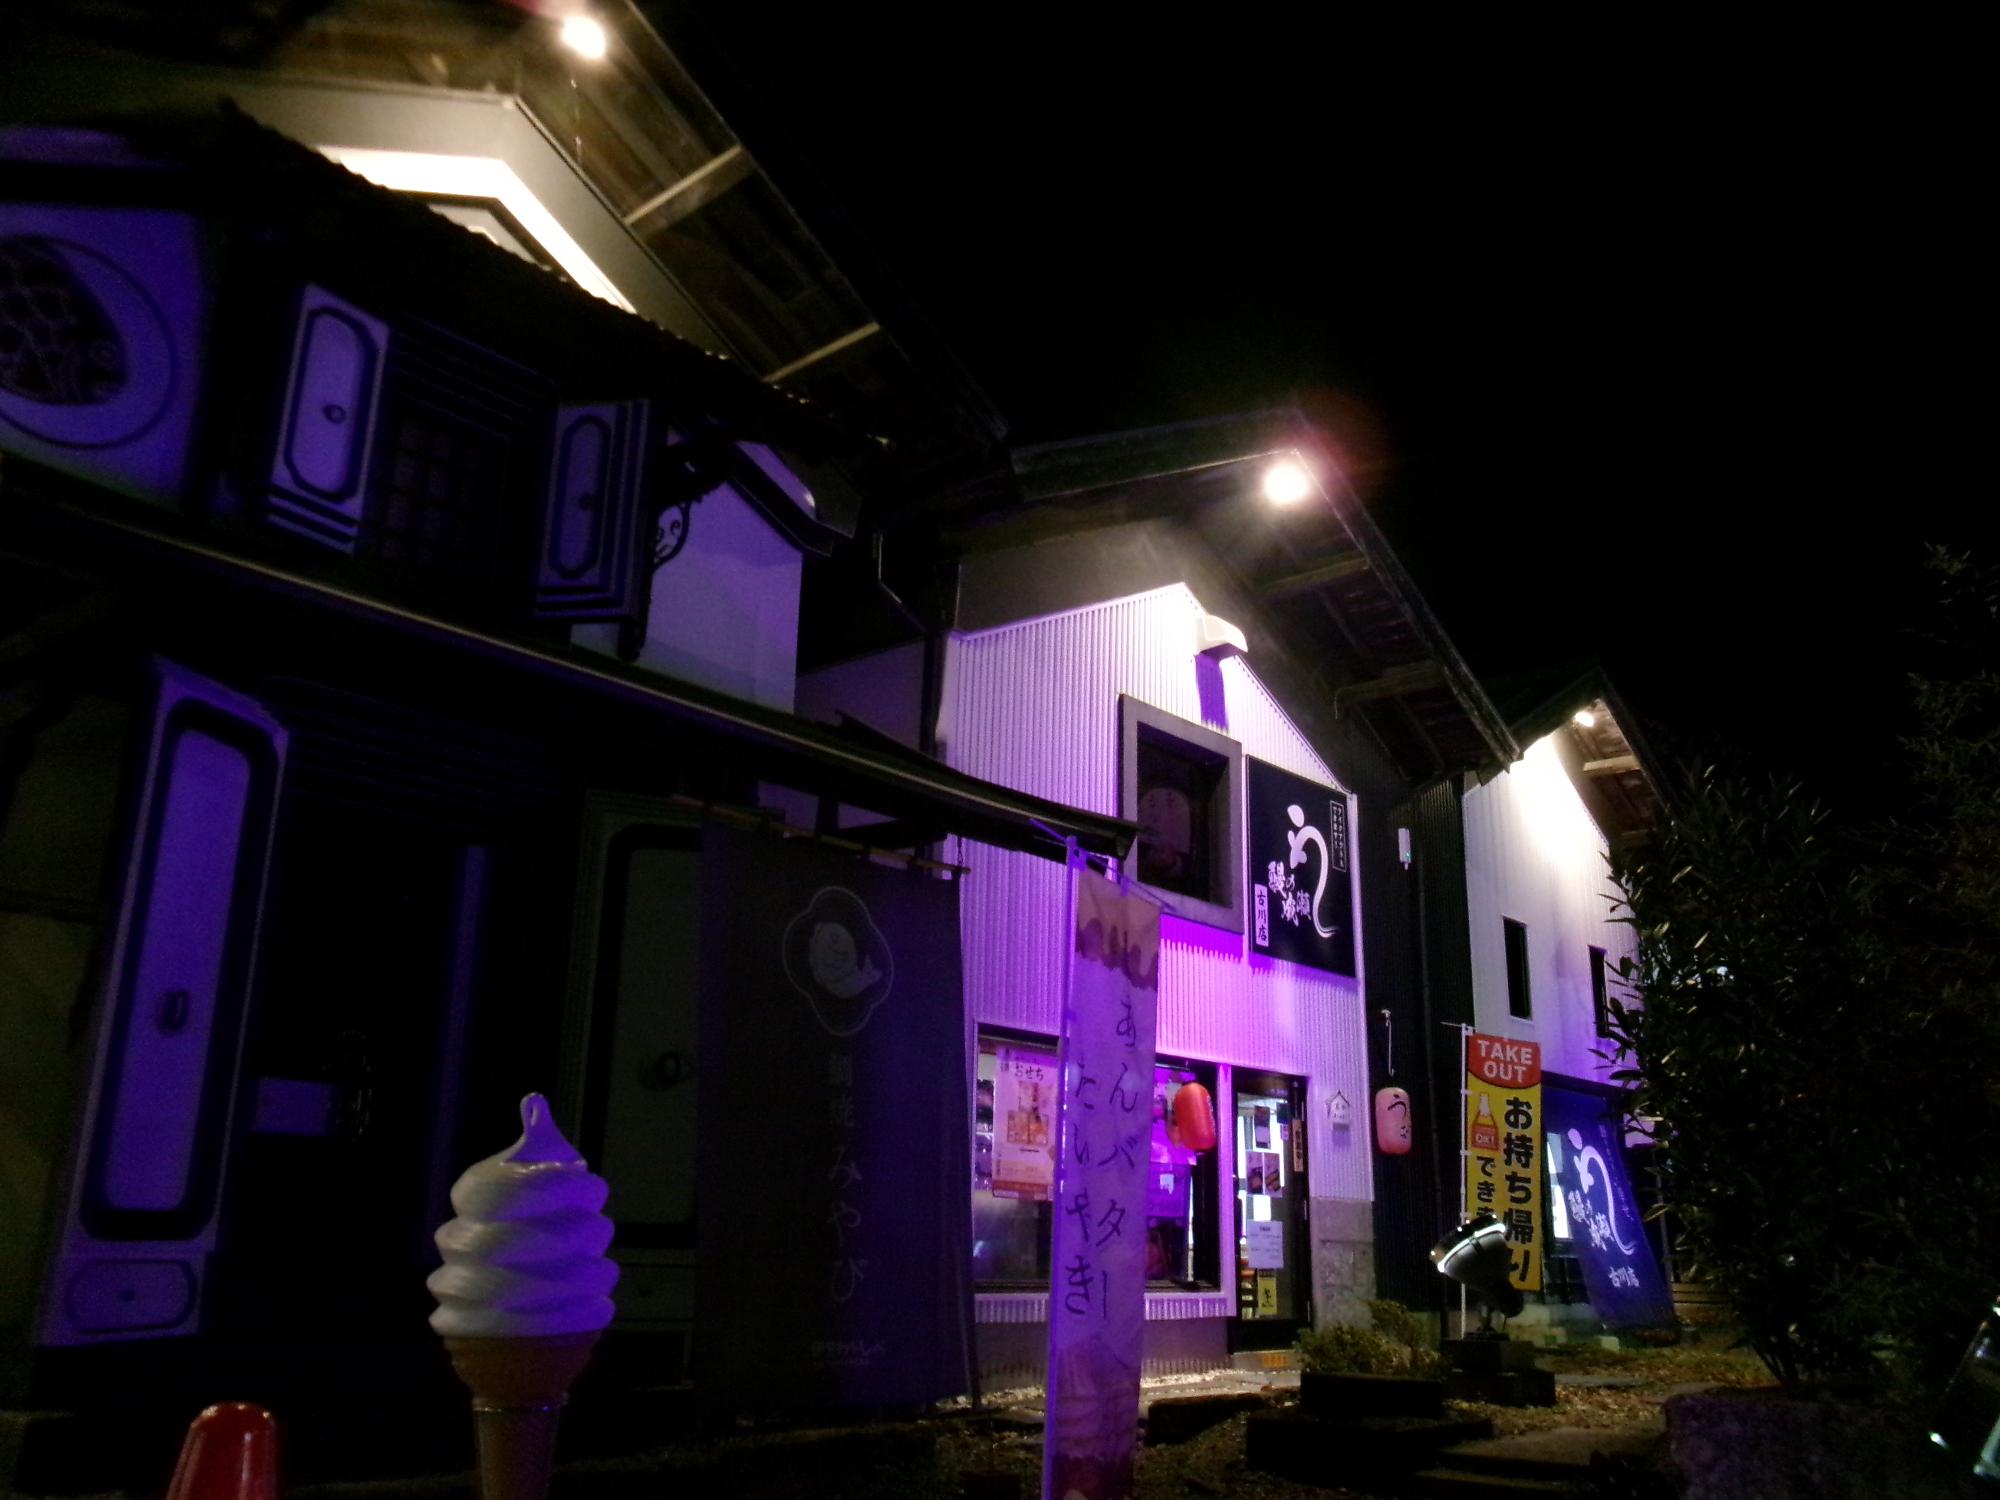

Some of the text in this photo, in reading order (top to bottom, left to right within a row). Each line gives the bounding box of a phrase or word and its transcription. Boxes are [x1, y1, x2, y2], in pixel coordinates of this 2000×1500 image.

[1256, 890, 1268, 942] 古川店
[1477, 1039, 1534, 1064] TAKE
[1014, 1061, 1045, 1081] おせち
[1484, 1060, 1528, 1083] OUT
[1475, 1133, 1495, 1145] OK!
[1096, 998, 1139, 1320] あんバター
[1502, 1096, 1535, 1283] お持ち帰り
[1608, 1265, 1641, 1289] 古川店
